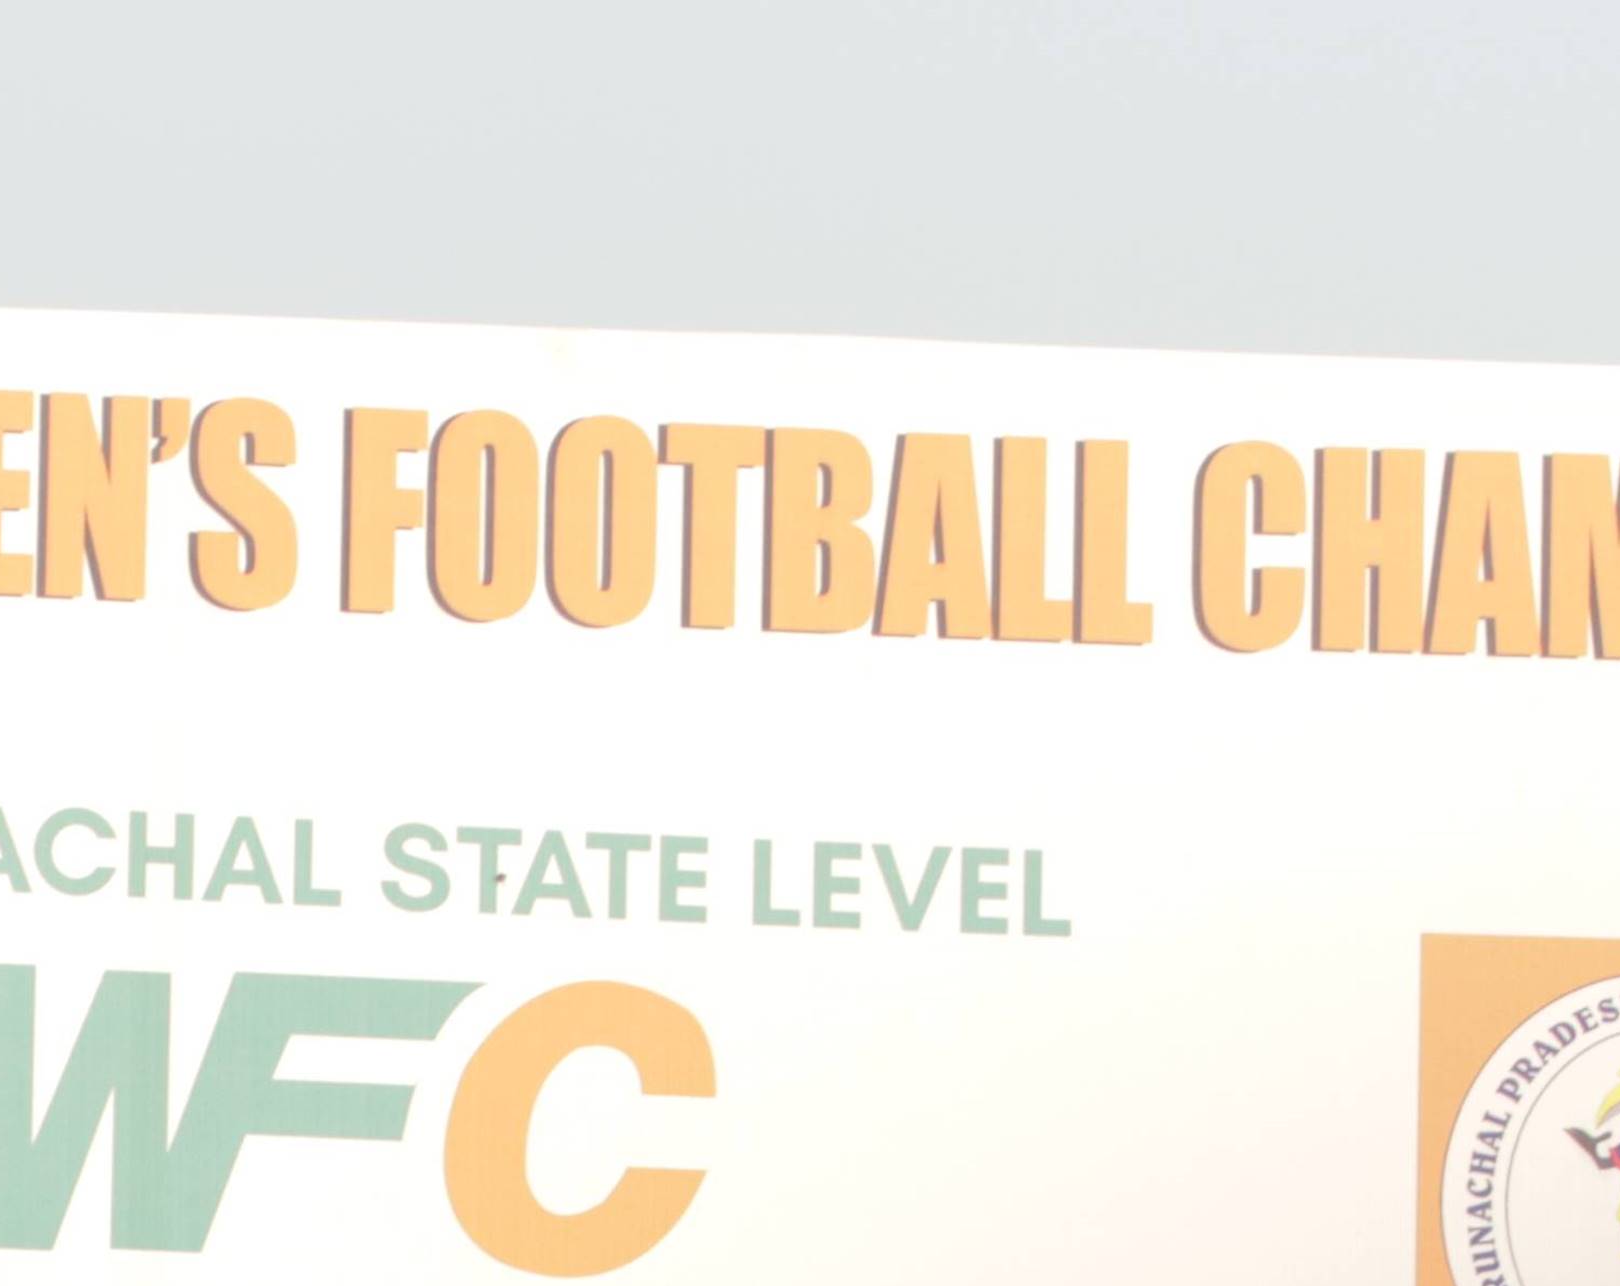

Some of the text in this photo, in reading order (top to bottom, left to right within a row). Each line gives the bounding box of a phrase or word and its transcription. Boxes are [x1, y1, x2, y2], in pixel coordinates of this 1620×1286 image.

[339, 406, 1156, 646] FOOTBALL
[379, 821, 708, 925] STATE
[750, 837, 1073, 938] LEVEL
